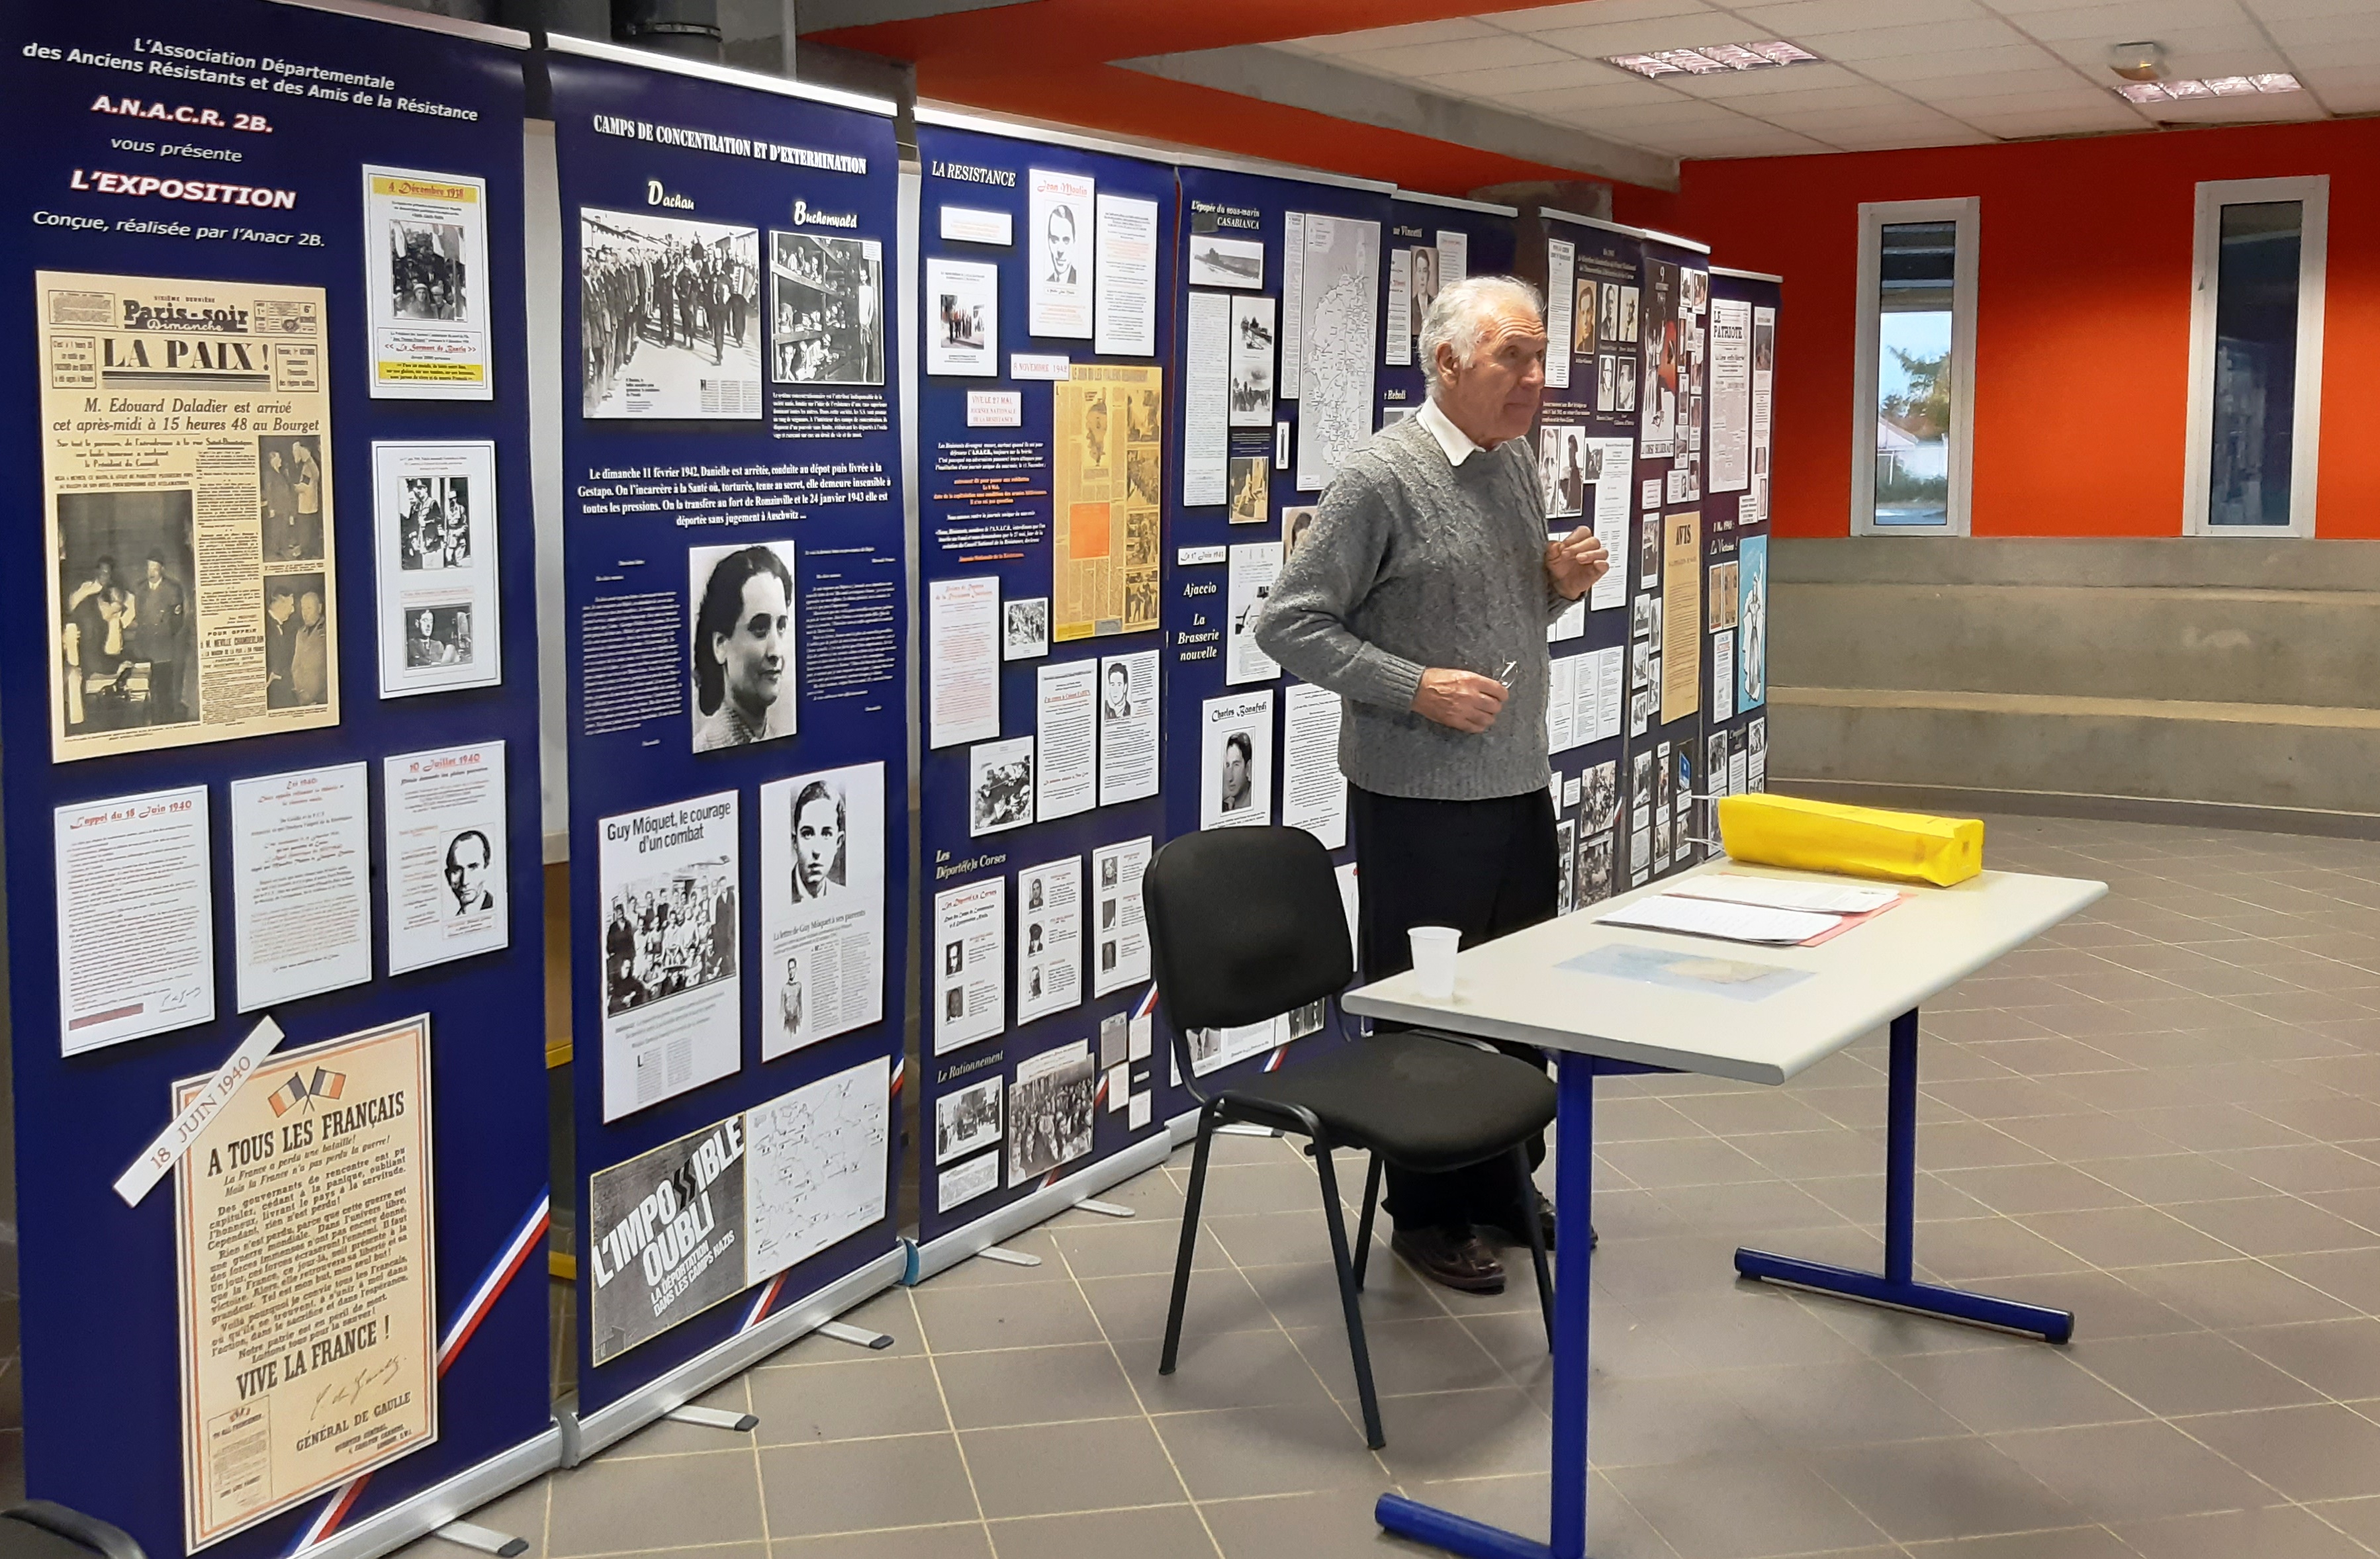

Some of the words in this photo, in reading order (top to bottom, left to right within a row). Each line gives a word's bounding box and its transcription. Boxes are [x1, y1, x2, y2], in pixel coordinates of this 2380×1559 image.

[134, 38, 255, 68] L'Association
[261, 58, 394, 90] Départementale
[23, 42, 62, 60] des
[66, 48, 143, 71] Anciens
[148, 60, 245, 86] Résistants
[250, 77, 269, 90] et
[273, 79, 303, 95] des
[307, 84, 348, 101] Amis
[353, 91, 373, 105] de
[377, 94, 392, 107] la
[396, 97, 477, 120] Résistance
[91, 95, 224, 126] A.N.A.C.R.
[233, 113, 272, 132] 2B.
[111, 138, 154, 152] vous
[160, 143, 242, 161] présente
[594, 114, 634, 137] CAMPS
[637, 122, 653, 140] DE
[656, 126, 751, 156] CONCENTRATION
[753, 141, 767, 159] ET
[769, 144, 866, 174] D'EXTERMINATION
[932, 161, 946, 177] LA
[947, 163, 1016, 187] RESISTANCE
[71, 170, 295, 208] L'EXPOSITION
[648, 181, 694, 210] Dachau
[1037, 180, 1058, 193] Jean
[1060, 183, 1087, 196] Moulin
[794, 201, 857, 228] Buchenwald
[1216, 204, 1224, 214] du
[1226, 207, 1259, 218] sous-marin
[33, 211, 109, 232] Conçue,
[116, 218, 191, 236] réalisée
[195, 227, 228, 239] par
[232, 228, 293, 243] l'Anacr
[298, 233, 324, 246] 2B.
[1217, 217, 1259, 230] CASABIANCA
[147, 320, 224, 332] Dimanche
[1714, 310, 1721, 323] LE
[1714, 326, 1742, 339] PATRIOTE
[102, 338, 152, 368] LA
[165, 339, 254, 371] PAIX
[1019, 363, 1049, 372] NOVEMBRE
[84, 397, 101, 412] M.
[109, 397, 165, 412] Edouard
[171, 398, 228, 412] Daladier
[234, 402, 250, 413] est
[257, 400, 291, 413] arrivé
[53, 419, 71, 431] cet
[76, 416, 142, 433] après-midi
[148, 418, 156, 430] à
[163, 416, 180, 431] 15
[186, 417, 226, 431] heures
[231, 417, 247, 431] 48
[252, 421, 267, 431] au
[273, 417, 320, 434] Bourget
[589, 468, 600, 479] Le
[602, 467, 641, 478] dimanche
[643, 467, 651, 478] 11
[681, 466, 699, 476] 1942,
[700, 465, 730, 476] Danielle
[731, 467, 742, 475] est
[771, 463, 798, 474] conduite
[831, 463, 847, 475] puis
[848, 463, 868, 472] livrée
[870, 462, 874, 472] à
[875, 462, 882, 471] la
[577, 486, 614, 498] Gestapo.
[615, 484, 628, 495] On
[673, 483, 678, 493] à
[680, 482, 686, 493] la
[688, 482, 708, 492] Santé
[721, 480, 755, 492] torturée,
[783, 480, 805, 489] secret,
[805, 478, 818, 488] elle
[819, 478, 851, 488] demeure
[852, 476, 885, 486] insensible
[1676, 524, 1691, 545] AVIS
[1183, 582, 1216, 598] Ajaccio
[1193, 613, 1205, 626] La
[1177, 629, 1219, 644] Brasserie
[1180, 646, 1217, 661] nouvelle
[1212, 708, 1234, 722] Charles
[423, 757, 456, 772] Juillet
[459, 753, 481, 766] 1940
[111, 811, 122, 821] du
[139, 805, 166, 819] Juin
[169, 800, 193, 811] 1940
[607, 823, 630, 842] Guy
[633, 811, 677, 836] Môquet,
[679, 809, 688, 824] le
[690, 801, 731, 823] courage
[639, 831, 662, 853] d'un
[664, 823, 704, 847] combat
[936, 850, 950, 863] Les
[980, 854, 1006, 868] Corses
[937, 1070, 947, 1084] Le
[949, 1049, 1003, 1079] Rationnement
[150, 1146, 171, 1171] 18
[177, 1096, 217, 1144] JUIN
[217, 1055, 252, 1096] 1940
[207, 1147, 223, 1178] A
[228, 1130, 274, 1169] TOUS
[282, 1118, 313, 1153] LES
[322, 1091, 404, 1141] FRANÇAIS
[224, 1174, 235, 1186] La
[239, 1165, 267, 1181] France
[278, 1154, 301, 1169] perdu
[304, 1149, 319, 1159] une
[643, 1190, 715, 1286] OUBLI
[653, 1289, 674, 1317] DANS
[674, 1275, 689, 1296] LES
[688, 1250, 713, 1282] CAMPS
[713, 1229, 735, 1258] NAZIS
[651, 1287, 663, 1304] LA
[237, 1360, 277, 1400] VIVE
[283, 1352, 307, 1381] LA
[311, 1321, 377, 1370] FRANCE
[296, 1420, 349, 1451] GÉNÉRAL
[354, 1410, 369, 1426] DE
[374, 1391, 411, 1417] GAULLE
